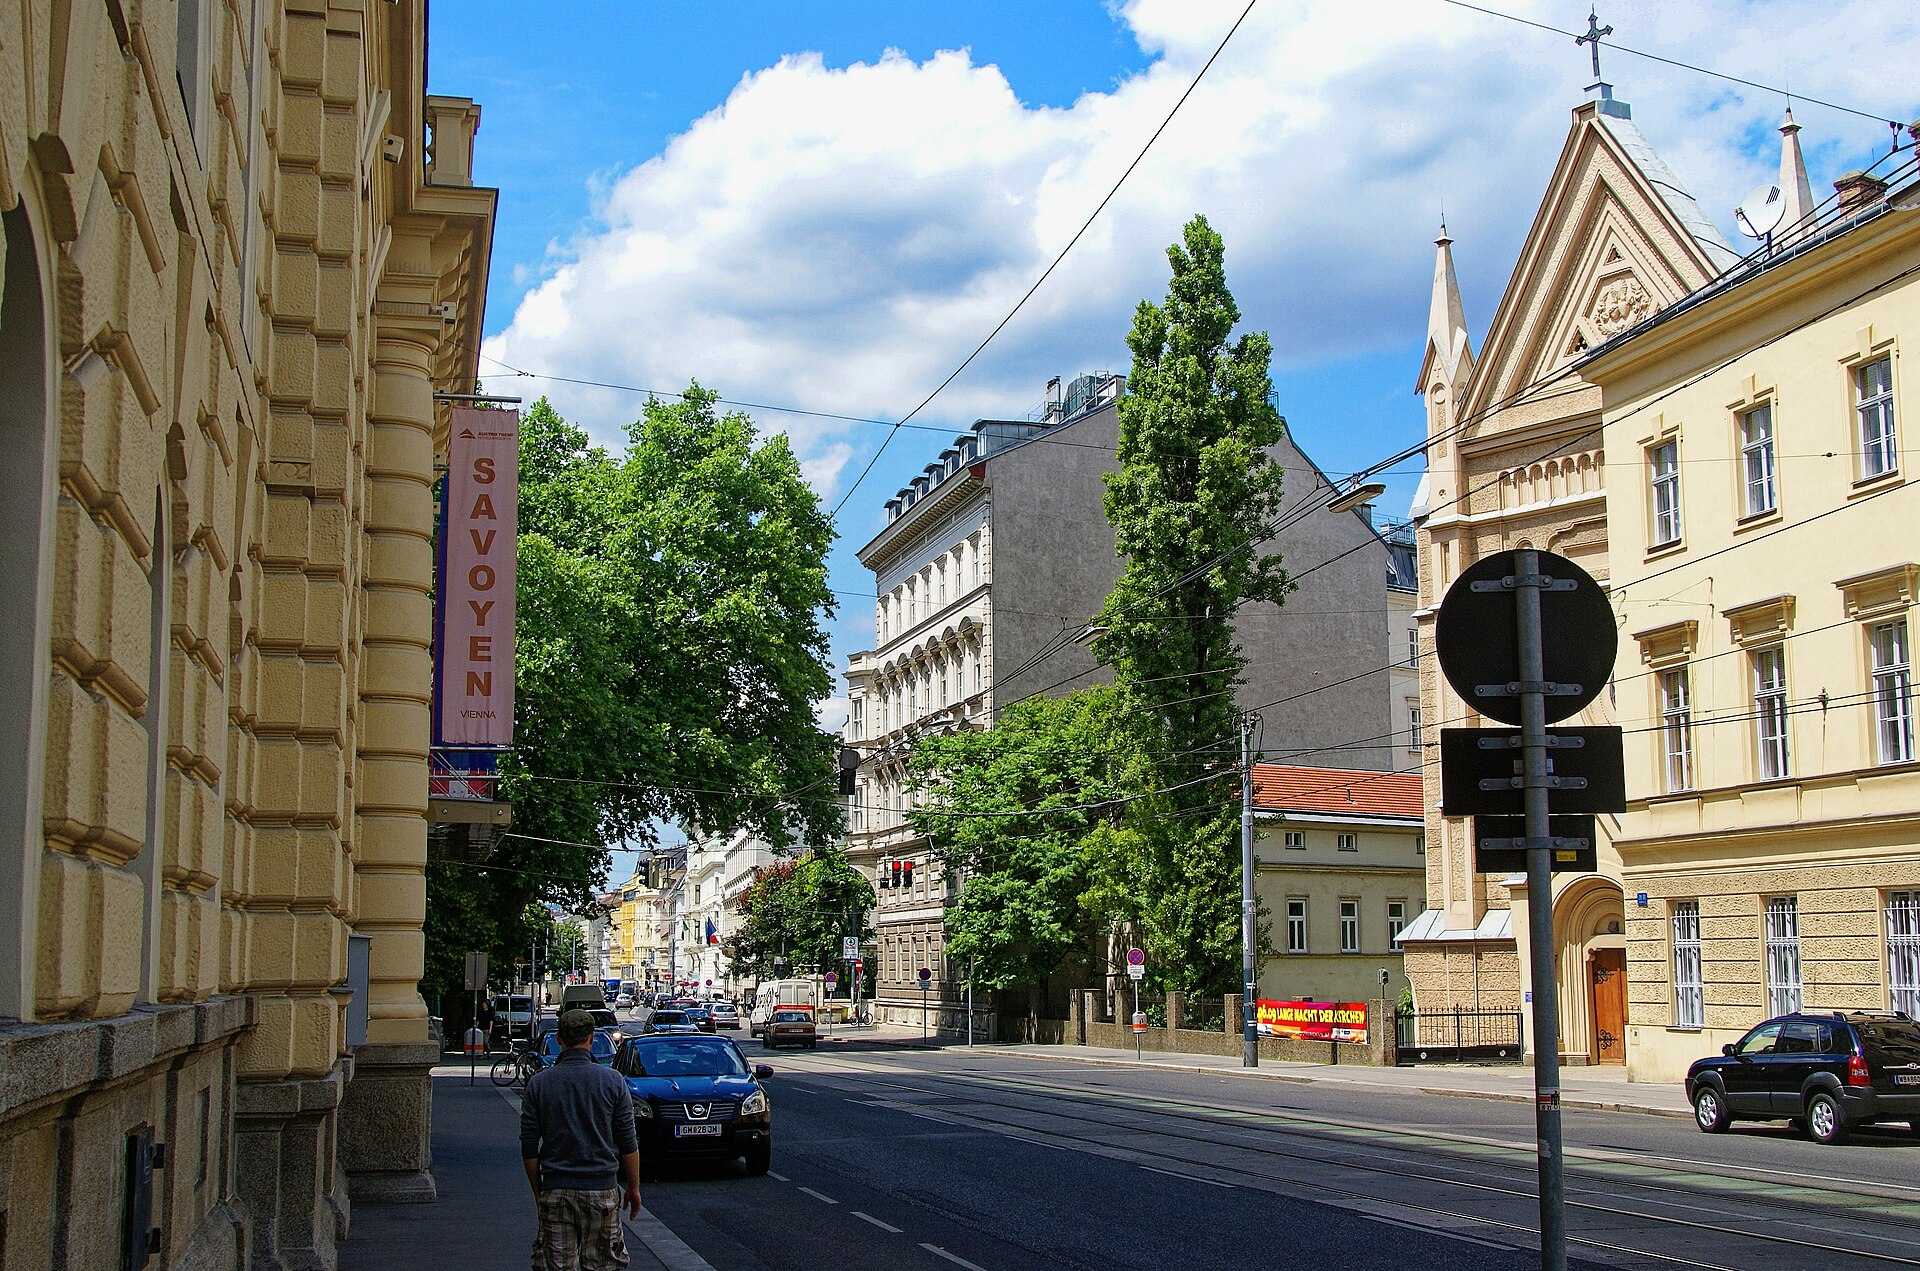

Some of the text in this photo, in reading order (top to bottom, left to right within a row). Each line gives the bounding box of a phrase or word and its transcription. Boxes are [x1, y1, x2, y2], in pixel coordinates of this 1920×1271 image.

[466, 457, 498, 697] SAVOYEN
[460, 709, 497, 719] VIENNA
[1277, 1008, 1294, 1021] LANGE
[1294, 1009, 1317, 1022] NACHT
[1319, 1010, 1333, 1023] DER
